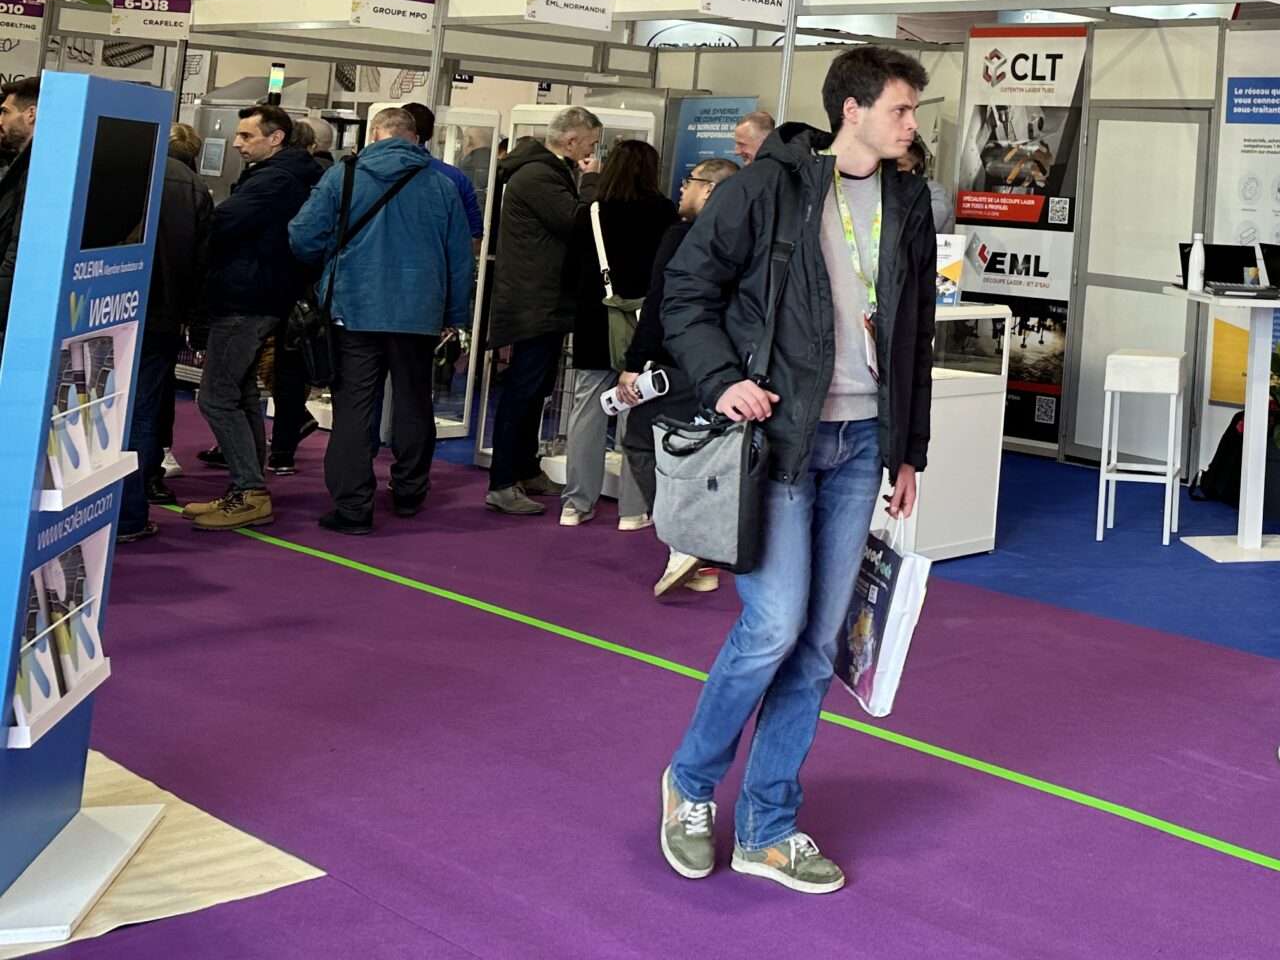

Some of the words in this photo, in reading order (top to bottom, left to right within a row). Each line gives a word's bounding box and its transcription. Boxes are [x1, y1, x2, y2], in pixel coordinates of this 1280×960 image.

[372, 6, 407, 17] GROUPE
[409, 11, 428, 20] MPO
[545, 0, 607, 14] EML_NORMANDIE
[143, 19, 184, 28] CRAFELEC
[1010, 53, 1063, 81] CLT
[1234, 87, 1243, 95] Le
[1245, 87, 1270, 95] réseau
[73, 260, 104, 280] SOLEWA
[984, 251, 1049, 278] EML
[89, 290, 139, 328] wewise
[38, 493, 113, 551] www.solewa.com
